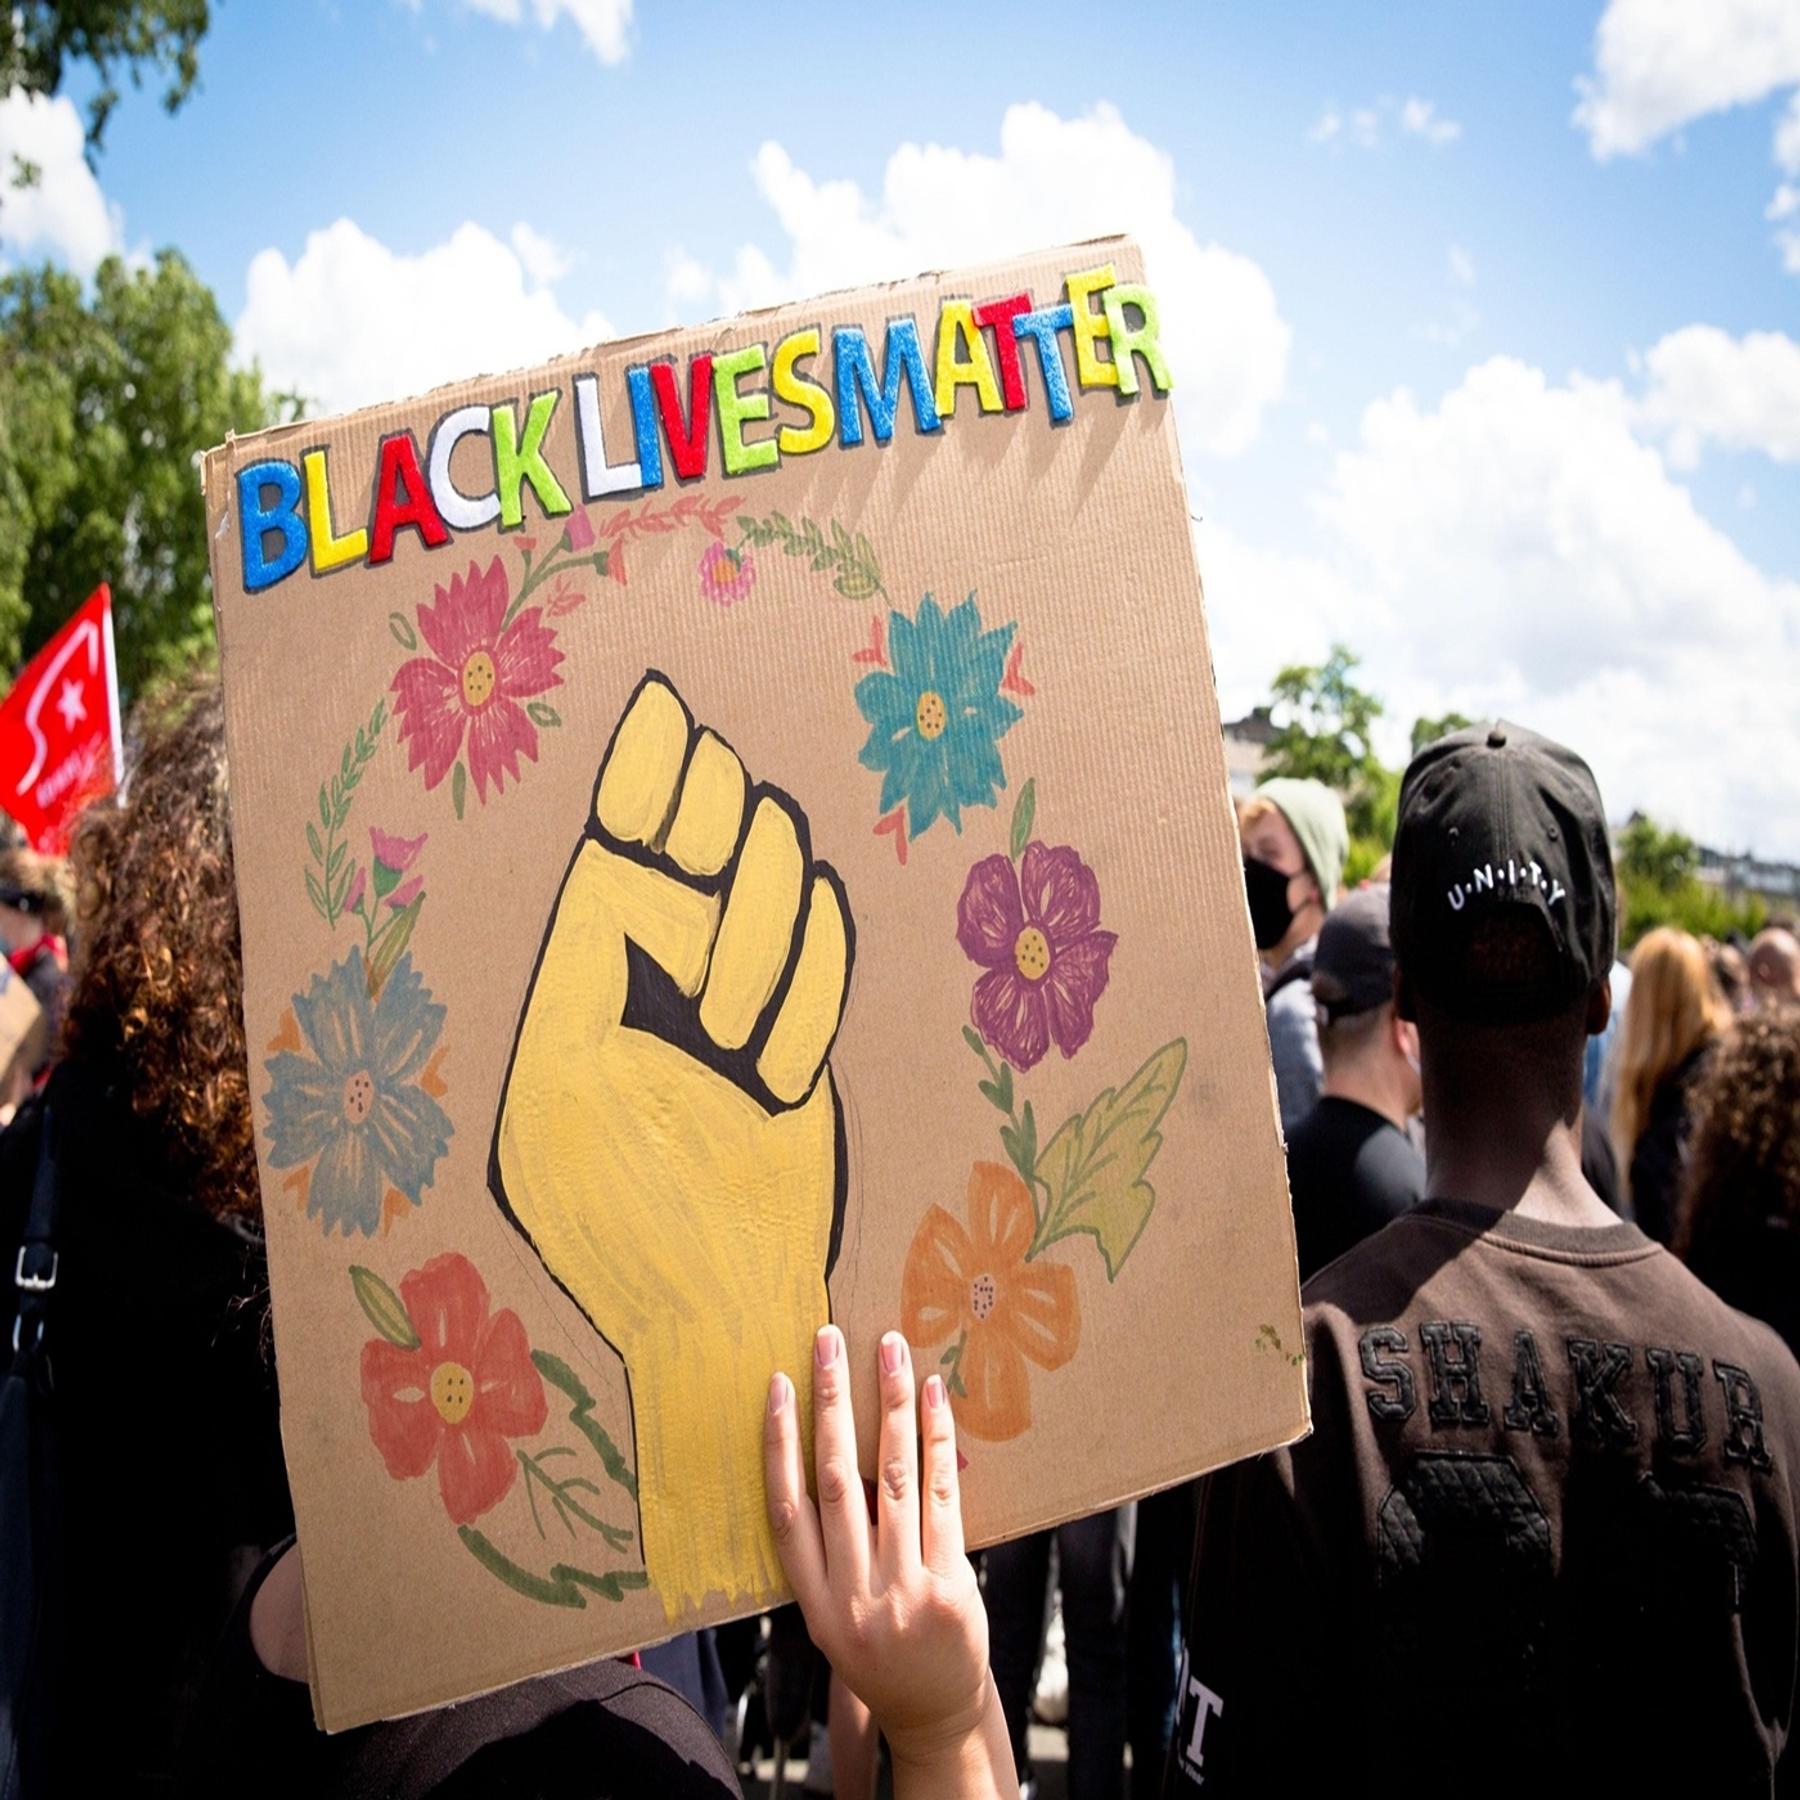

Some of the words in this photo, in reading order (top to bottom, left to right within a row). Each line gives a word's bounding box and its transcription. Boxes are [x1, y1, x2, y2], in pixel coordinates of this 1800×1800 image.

[238, 390, 573, 591] BLACK
[575, 329, 835, 499] LIVES
[833, 262, 1174, 445] MATTER
[1359, 1319, 1774, 1472] SHAKUR
